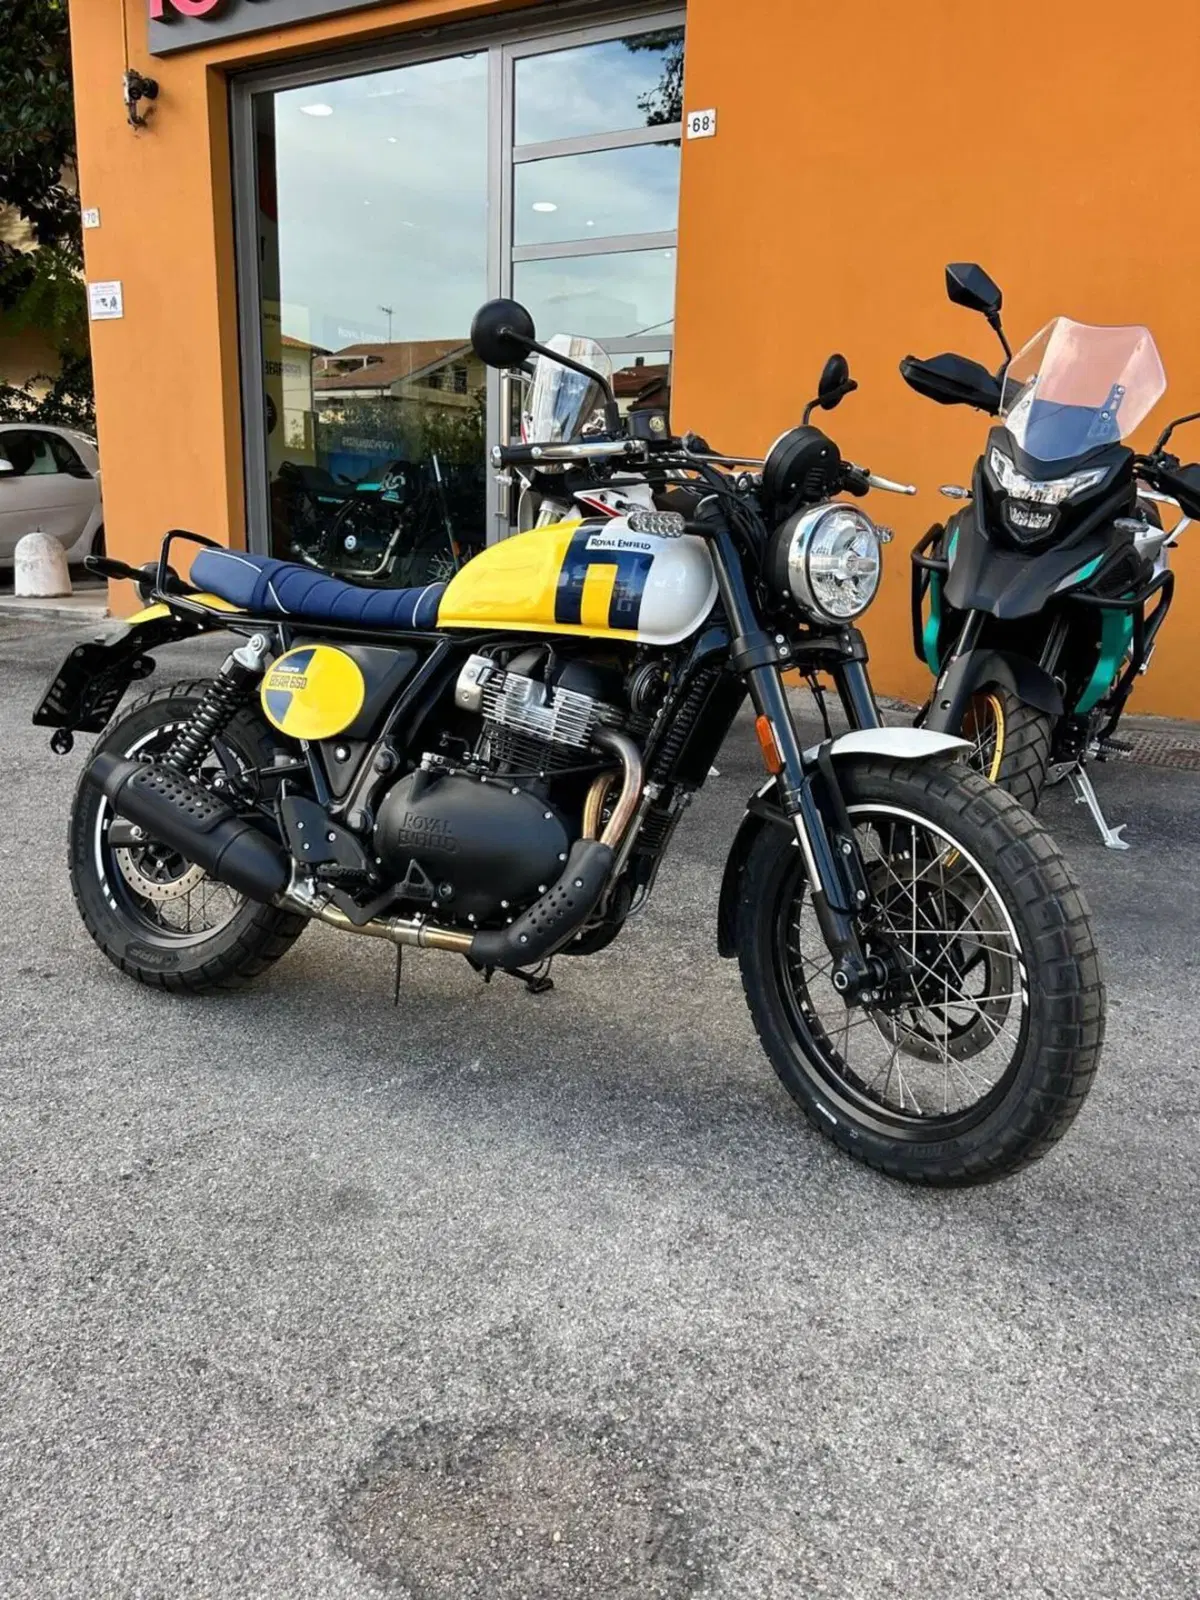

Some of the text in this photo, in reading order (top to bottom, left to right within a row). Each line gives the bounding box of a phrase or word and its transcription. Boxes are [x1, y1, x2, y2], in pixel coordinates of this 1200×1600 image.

[692, 115, 710, 133] 68
[590, 537, 652, 551] ROYAL ENFIELD
[269, 675, 307, 689] BEAR 650
[403, 811, 453, 833] ROYAL
